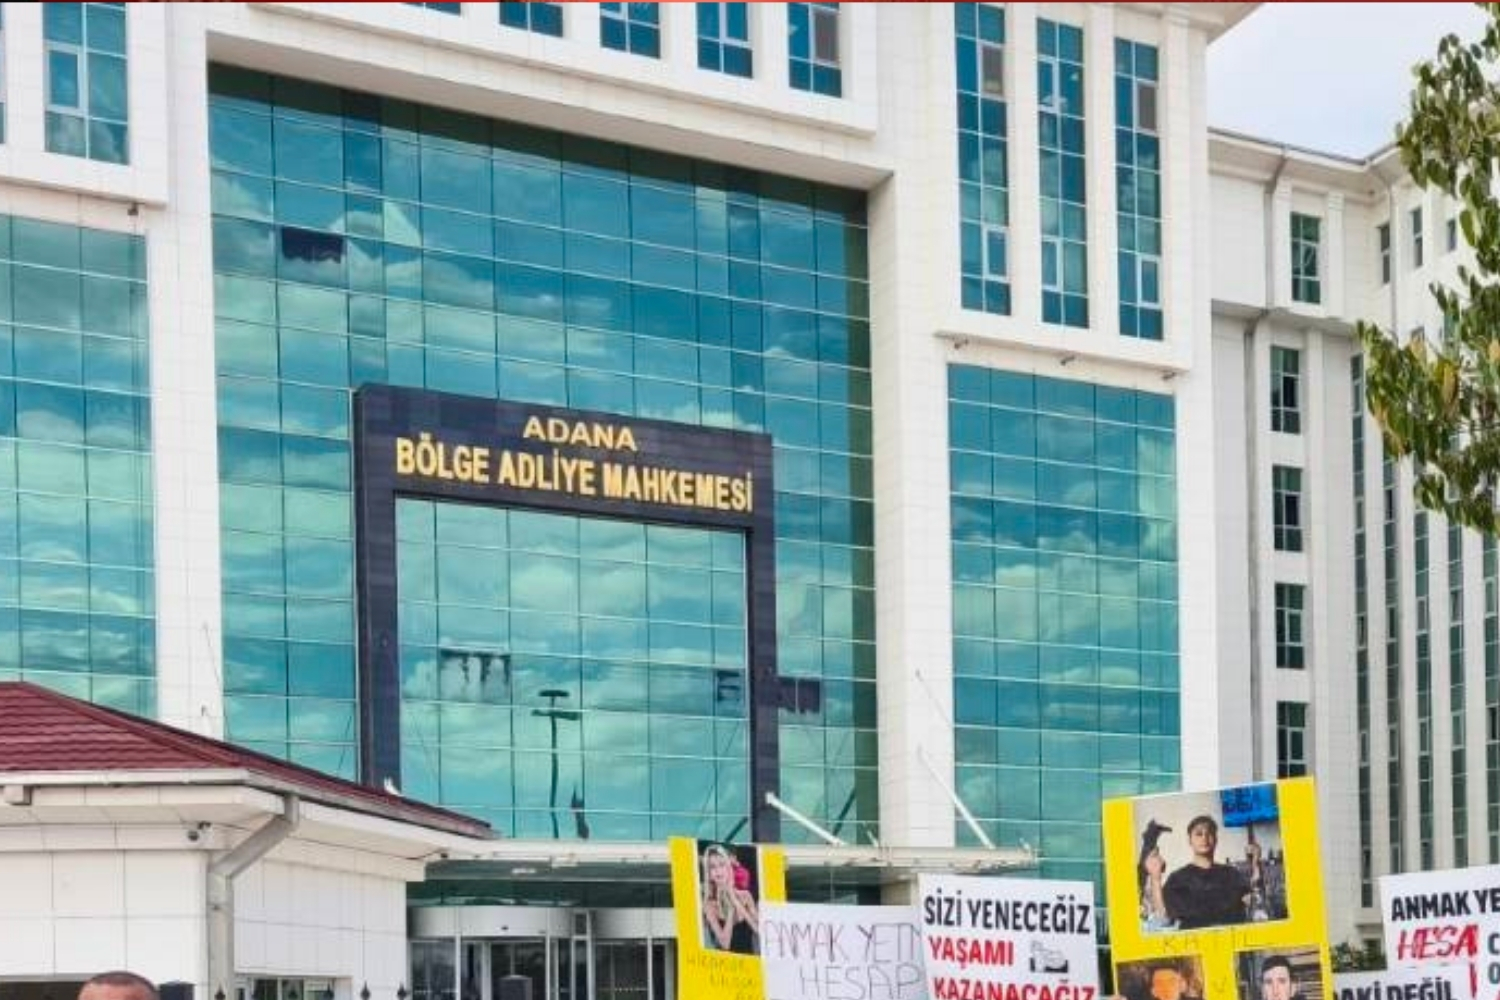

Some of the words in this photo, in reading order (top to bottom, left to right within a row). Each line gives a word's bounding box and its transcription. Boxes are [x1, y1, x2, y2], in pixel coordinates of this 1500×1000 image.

[523, 415, 637, 452] ADANA
[395, 431, 490, 483] BÖLGE
[498, 448, 595, 496] ADLİYE
[603, 464, 754, 513] MAHKEMESİ
[924, 887, 962, 927] SİZİ
[966, 894, 1091, 935] YENECEĞİZ
[1391, 890, 1471, 922] ANMAK
[928, 935, 1014, 970] YAŞAMI
[1397, 923, 1479, 961] HESA
[799, 962, 921, 1000] HESAP
